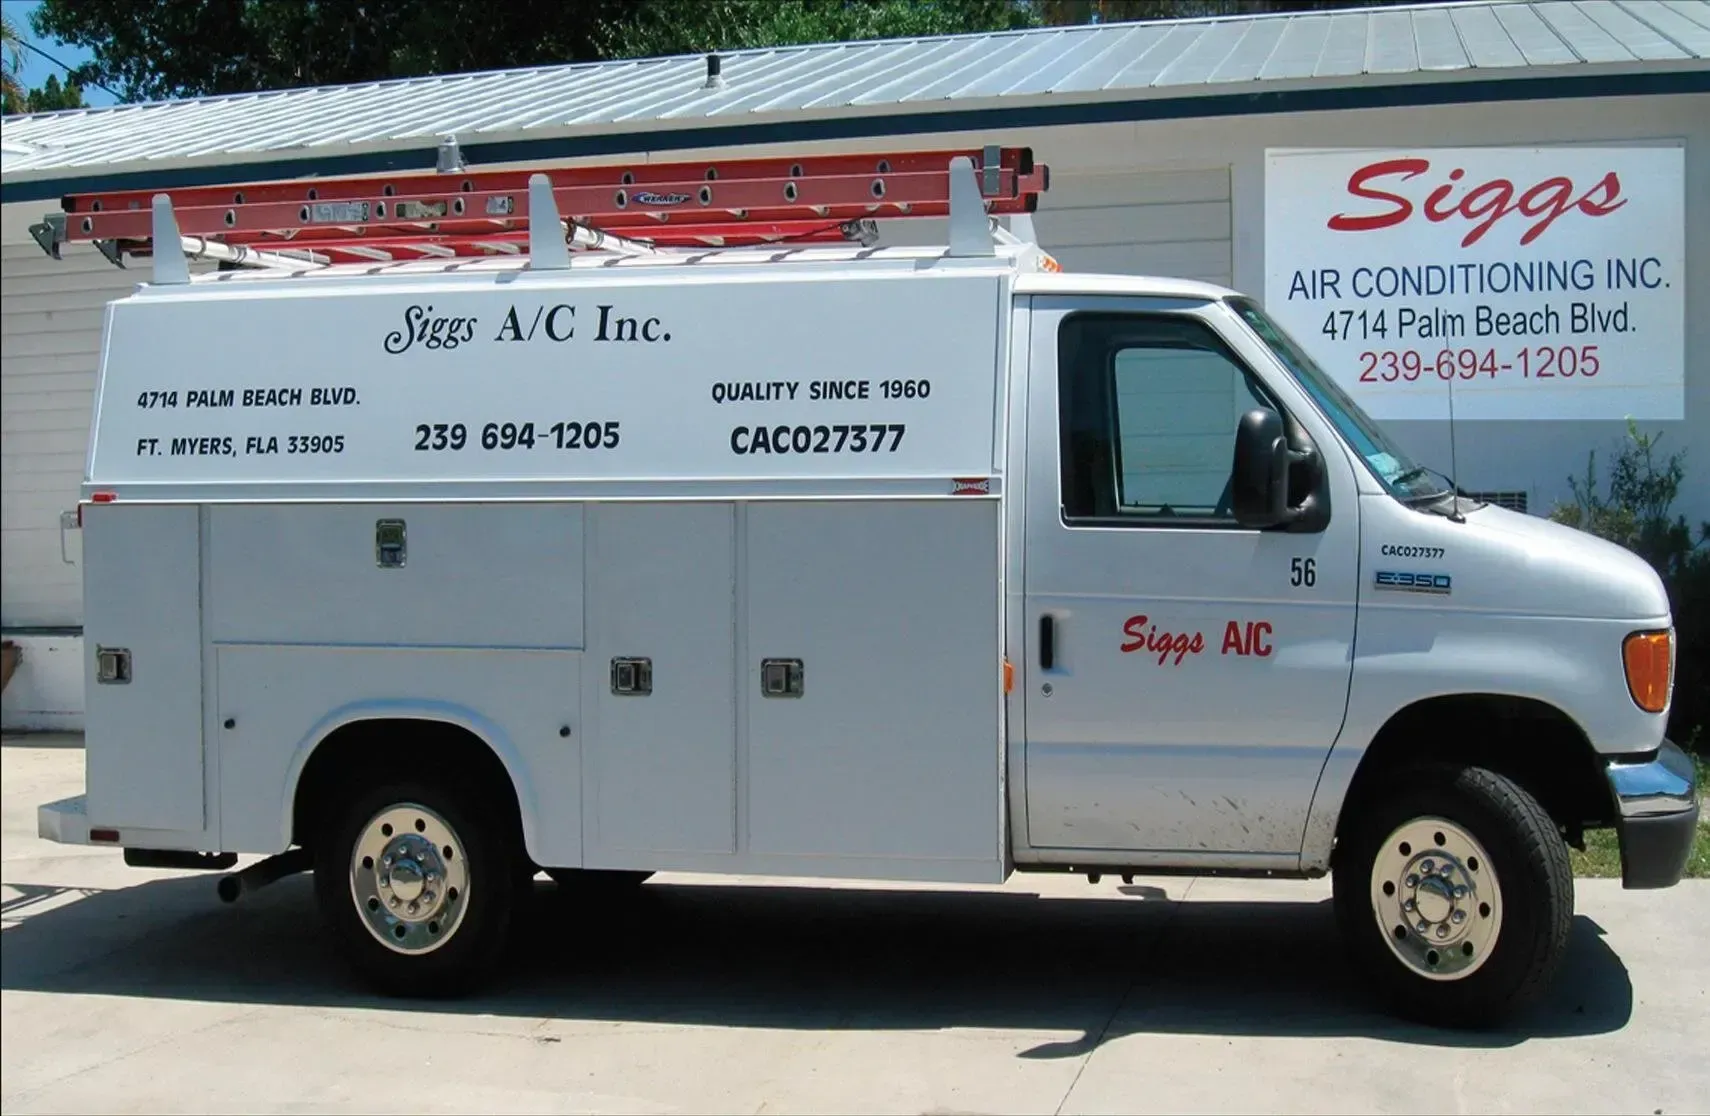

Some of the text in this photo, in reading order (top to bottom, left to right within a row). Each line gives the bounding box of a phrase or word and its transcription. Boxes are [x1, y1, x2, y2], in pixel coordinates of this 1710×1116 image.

[1327, 158, 1628, 249] Siggs
[1288, 256, 1671, 300] AIR CONDITIONING INC.
[384, 303, 672, 354] Siggs A/C Inc.
[1322, 301, 1637, 341] 4714 Palm Beach Blvd.
[1359, 345, 1600, 383] 239-694-1205
[137, 386, 361, 409] 4714 PALM BEACH BLVD.
[712, 379, 931, 404] QUALITY SINCE 1960
[137, 434, 345, 458] FT. MYERS, FLA 33905
[415, 421, 620, 451] 239 694-1205
[1290, 557, 1316, 588] 56
[1120, 615, 1204, 666] Siggs
